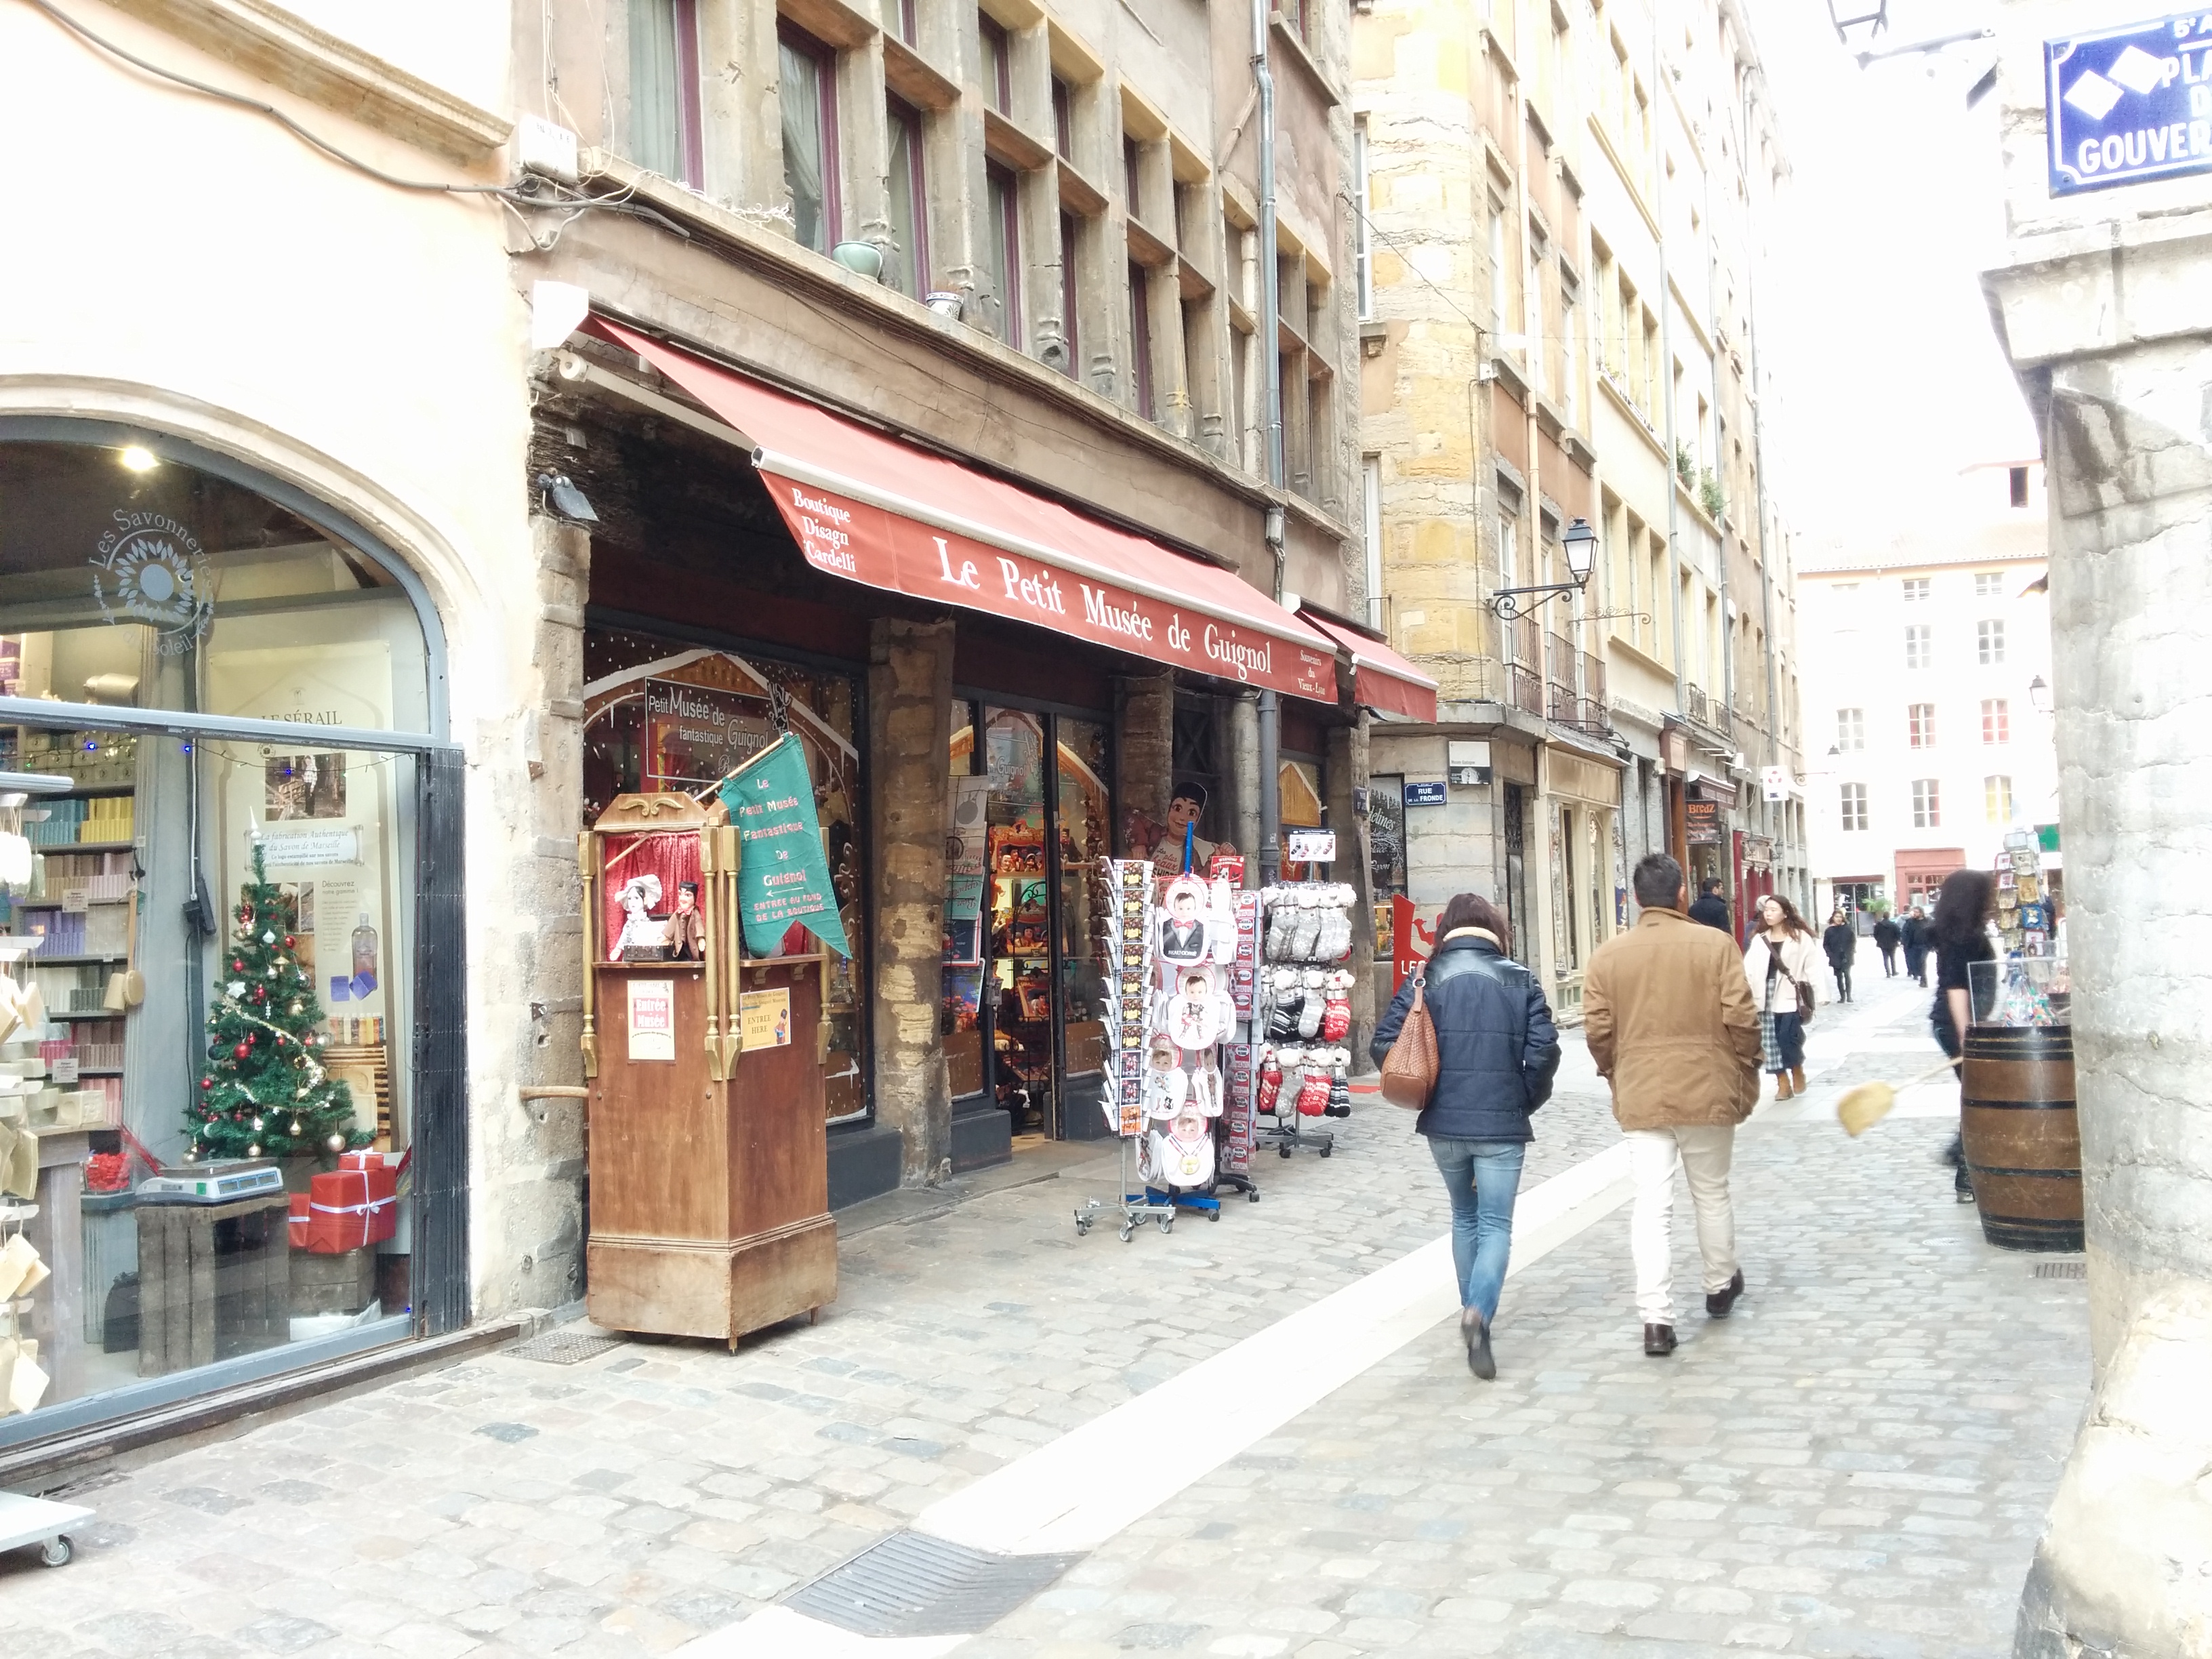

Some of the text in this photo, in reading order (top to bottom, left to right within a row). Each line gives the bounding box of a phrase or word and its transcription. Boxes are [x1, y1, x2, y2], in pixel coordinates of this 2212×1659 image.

[792, 487, 851, 525] Boutique
[801, 515, 849, 550] Disagn
[89, 508, 213, 588] Les Savonneries
[933, 536, 1273, 680] Le Petit Musée de Guignol
[1300, 649, 1322, 667] Souvenirs
[1308, 667, 1316, 678] du
[649, 687, 725, 727] Petit Musée de
[284, 710, 342, 725] SÉRAIL
[679, 718, 769, 755] fantastique Guignol
[996, 756, 1025, 782] Guignol
[757, 779, 770, 789] Le
[739, 796, 798, 817] Petit Musée
[271, 831, 307, 842] fabrication
[308, 829, 349, 840] Authentique
[743, 821, 803, 842] Fantastique
[279, 843, 300, 851] Savon
[301, 842, 310, 850] de
[310, 840, 340, 850] Marseille
[775, 850, 789, 860] De
[763, 869, 806, 887] Guignol
[754, 893, 822, 911] ENTREE AU FOND
[756, 903, 825, 922] DE LA BOUTIQUE
[1401, 960, 1426, 975] LE
[636, 998, 666, 1012] Entrée
[637, 1014, 665, 1028] Musée
[752, 1025, 768, 1035] HERE
